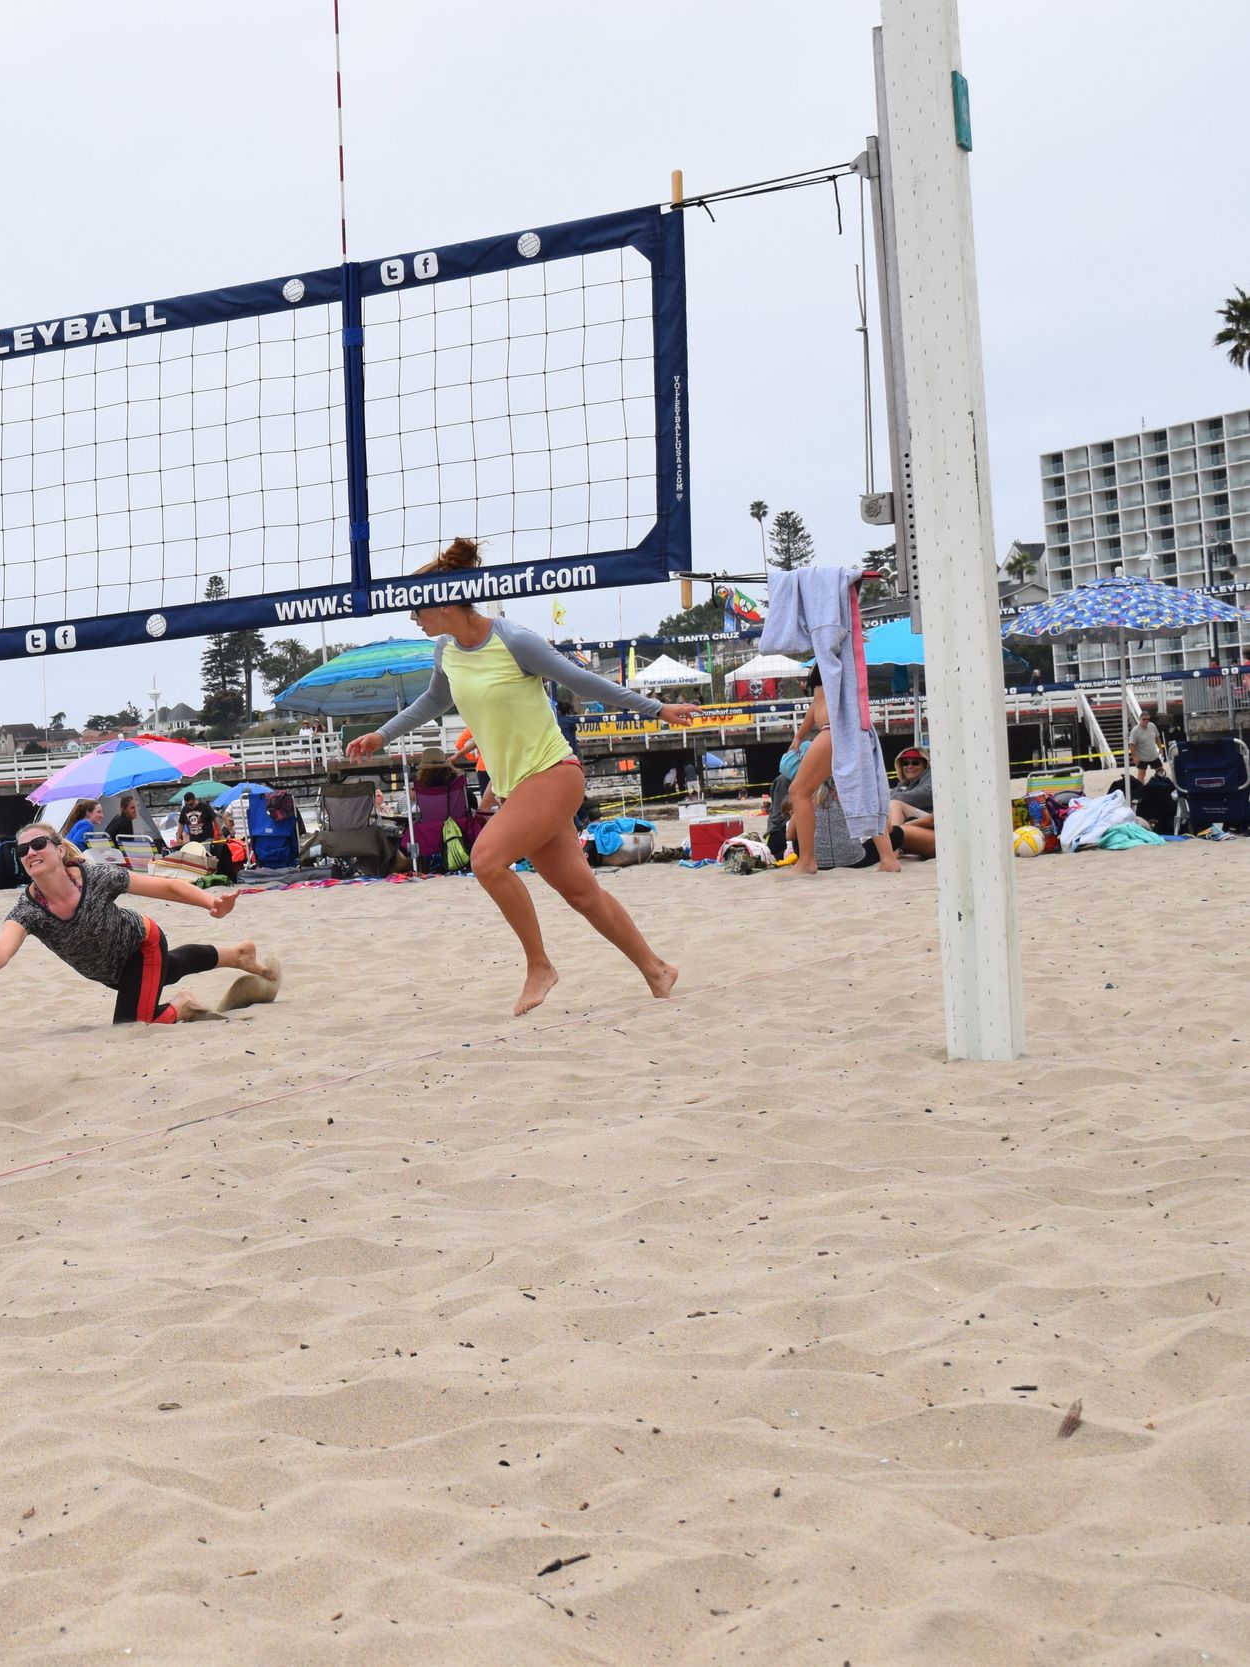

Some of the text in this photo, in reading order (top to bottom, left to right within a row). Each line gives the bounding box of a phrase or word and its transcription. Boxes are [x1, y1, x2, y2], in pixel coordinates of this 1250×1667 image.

[275, 565, 596, 620] www.sntacruzwharf.com
[1190, 584, 1250, 595] OLLEYB
[678, 632, 740, 643] SANTA CRUZ
[1073, 675, 1163, 689] www.santacruwharf.com
